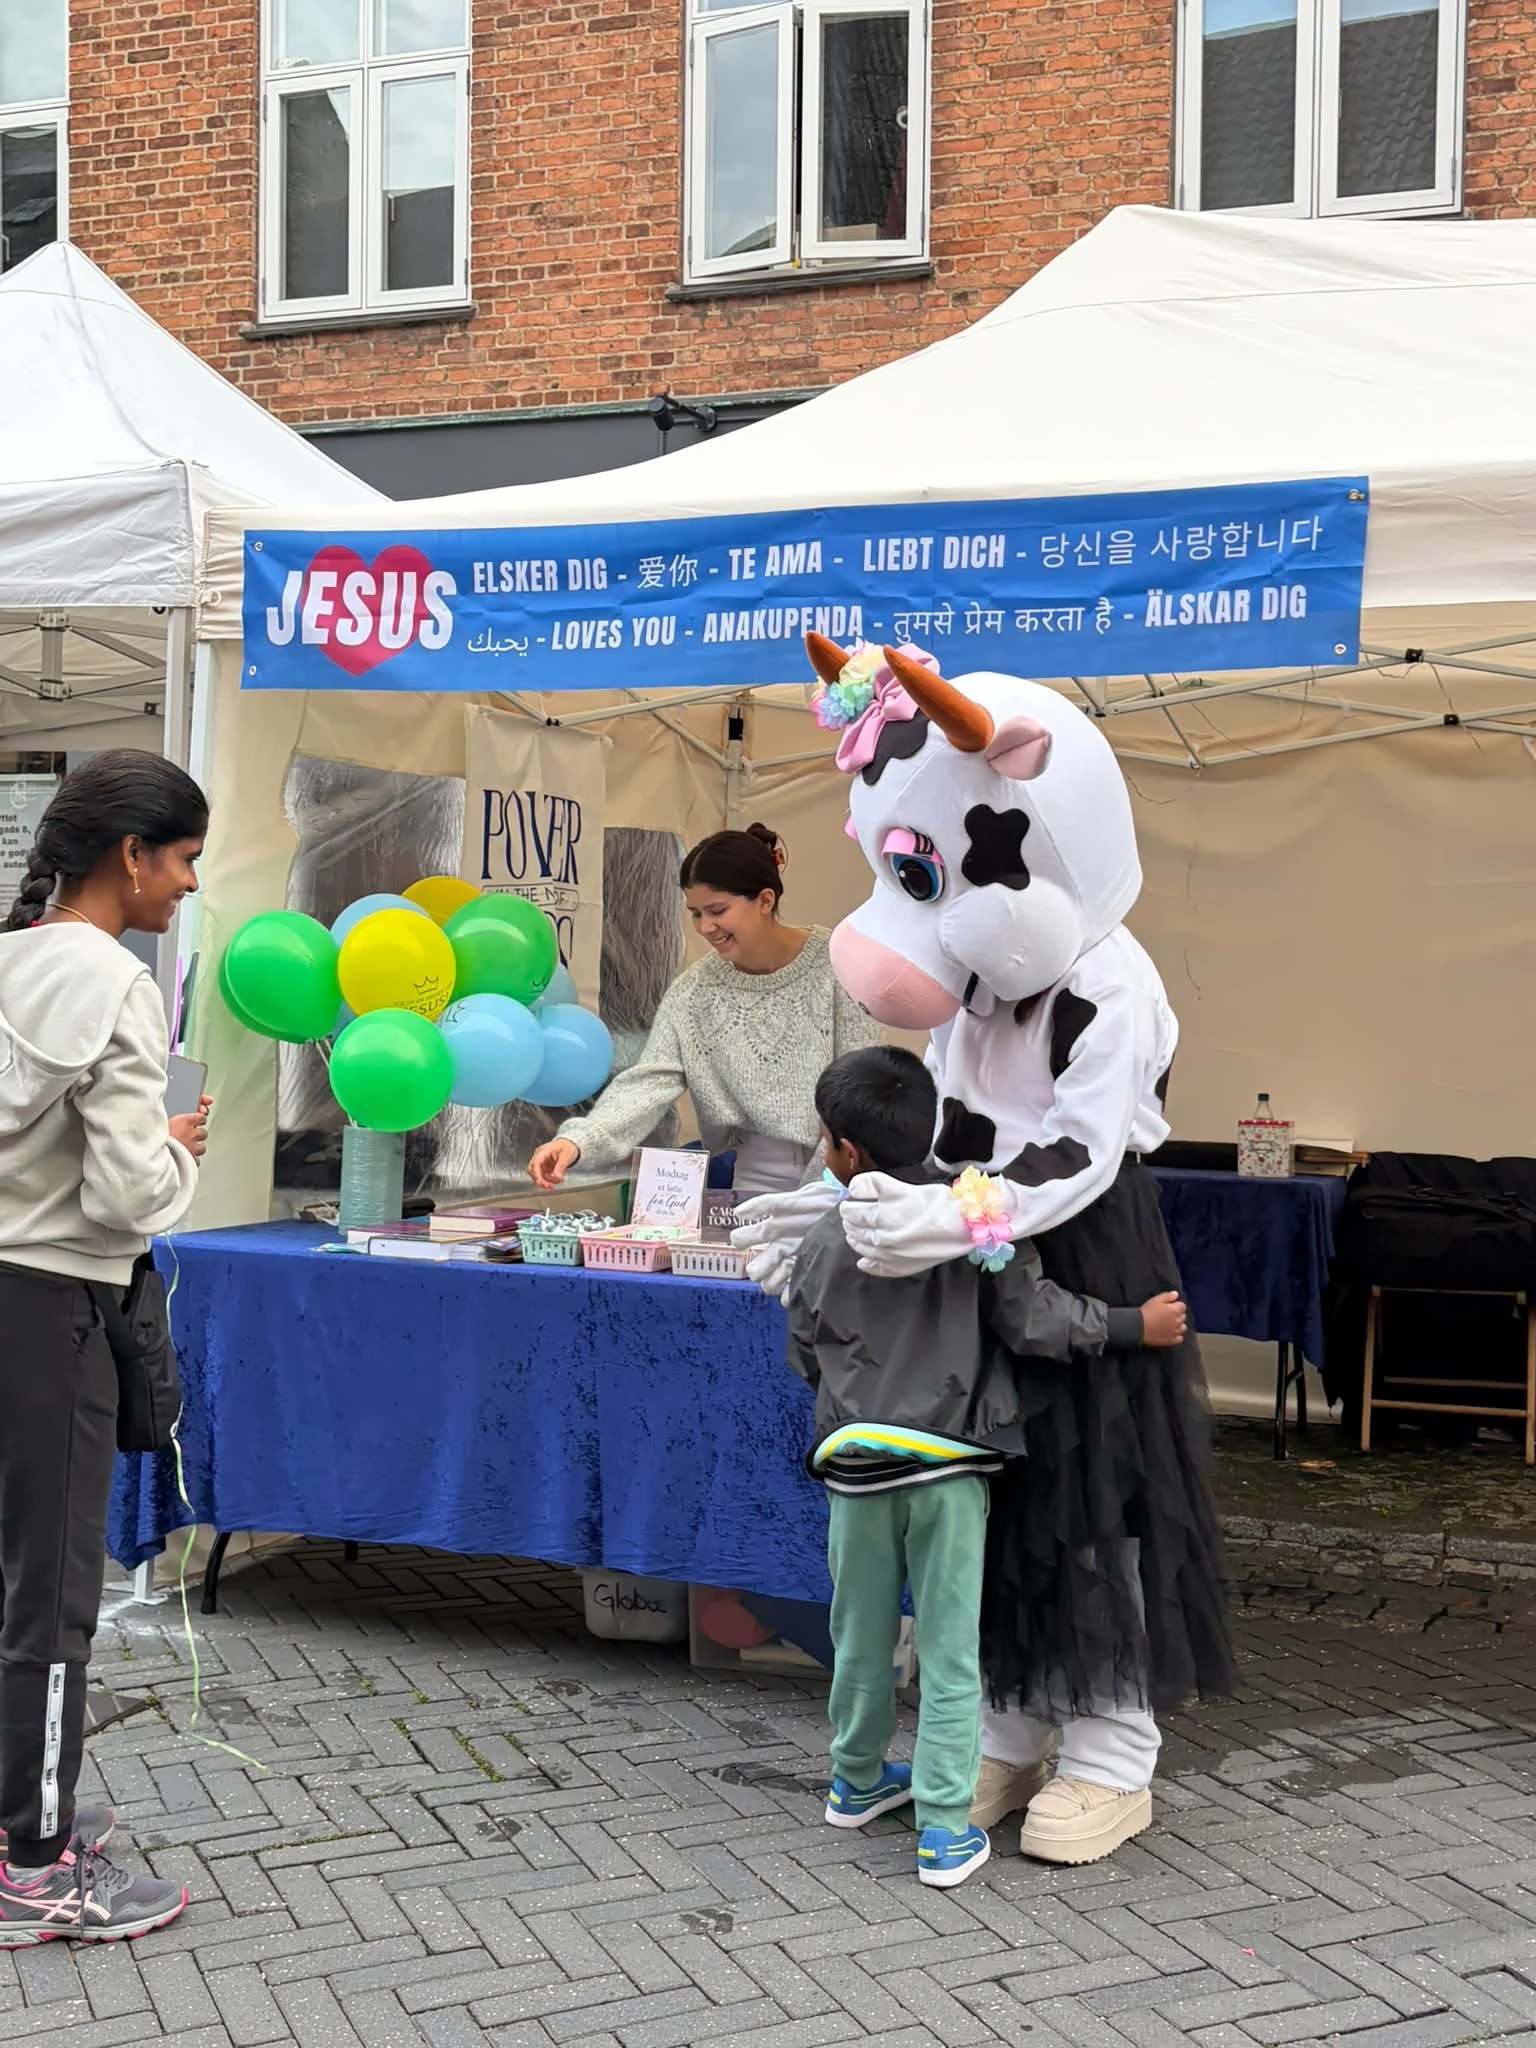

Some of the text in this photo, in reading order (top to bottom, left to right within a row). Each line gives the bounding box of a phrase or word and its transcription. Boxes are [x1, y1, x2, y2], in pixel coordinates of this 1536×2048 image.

[473, 559, 558, 594] ELSKER
[567, 557, 608, 591] DIG
[637, 554, 699, 589] 爱你
[728, 547, 756, 581] TE
[764, 541, 822, 577] AMA
[863, 536, 934, 572] LIEBT
[943, 534, 1006, 569] DICH
[1040, 529, 1137, 570] 당신을
[1150, 515, 1323, 562] 사랑합니다
[265, 570, 457, 650] JESUS
[467, 627, 529, 657] يحبك
[551, 619, 623, 651] LOVES
[632, 615, 676, 648] YOU
[702, 605, 863, 644] ANAKUPENDA
[893, 602, 956, 644] तुमसे
[964, 601, 1006, 635] प्रेम
[1014, 606, 1086, 633] करता
[1095, 596, 1115, 635] है
[1144, 588, 1251, 628] ÄLSKAR
[1261, 584, 1307, 621] DIG
[655, 1167, 689, 1181] Modtag
[707, 1215, 731, 1226] TOO
